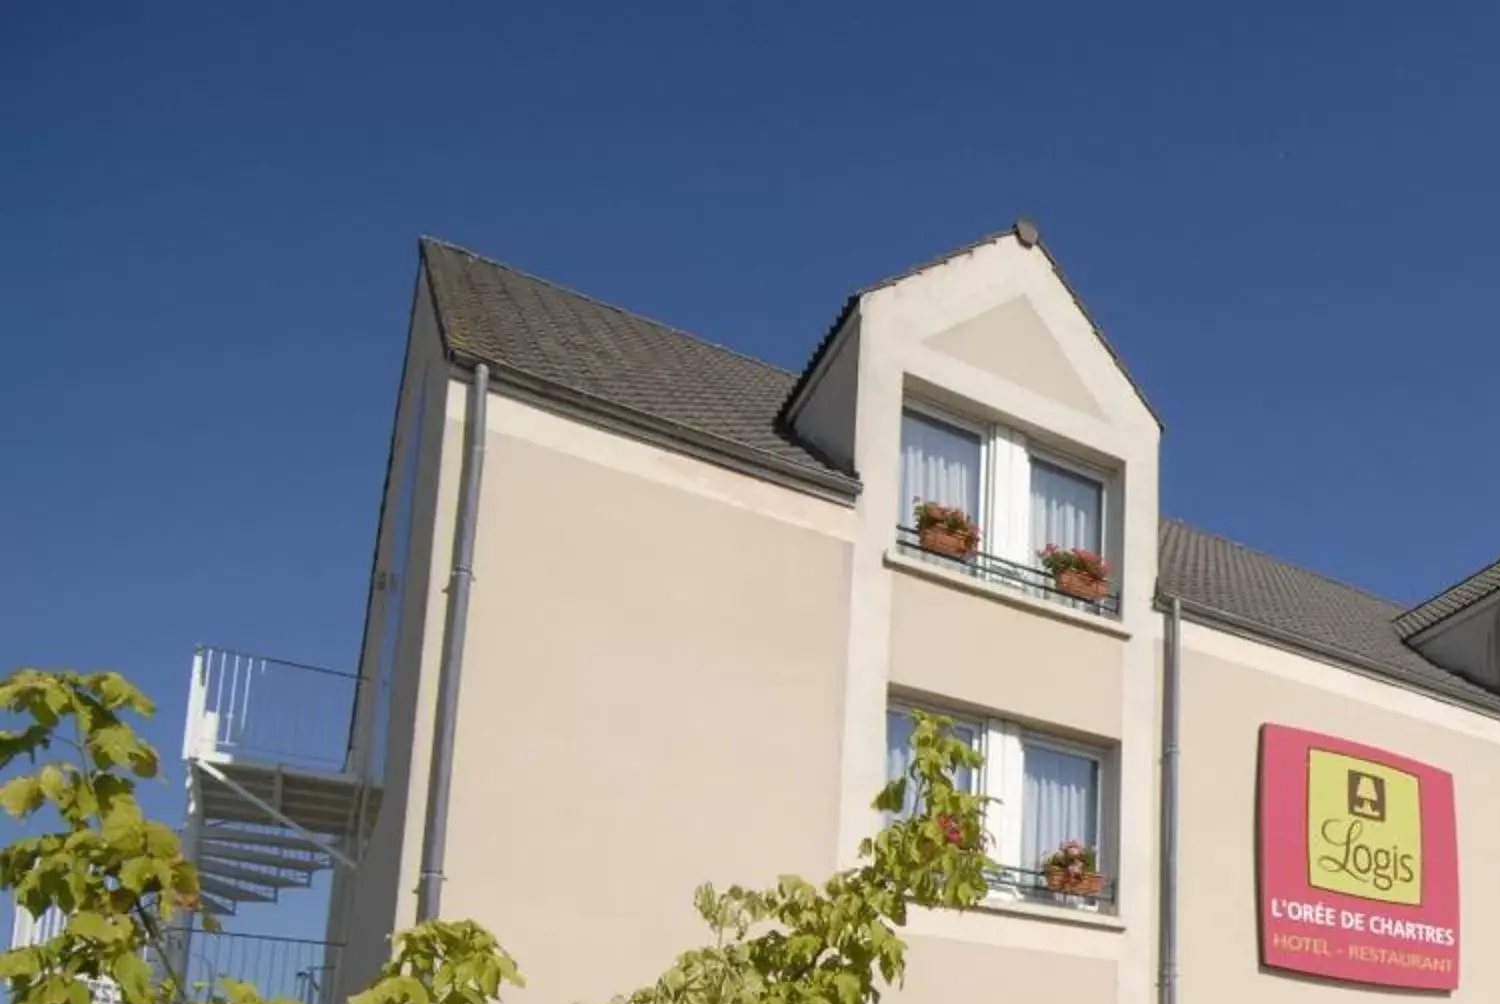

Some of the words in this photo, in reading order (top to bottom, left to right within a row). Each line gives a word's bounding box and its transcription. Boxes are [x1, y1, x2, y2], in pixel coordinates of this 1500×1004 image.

[1319, 818, 1414, 890] Logis
[1271, 897, 1336, 927] L'ORÉE
[1341, 910, 1365, 931] DE
[1369, 915, 1454, 945] CHARTRES
[1273, 933, 1330, 956] HOTEL
[1348, 945, 1452, 973] RESTAURANT
